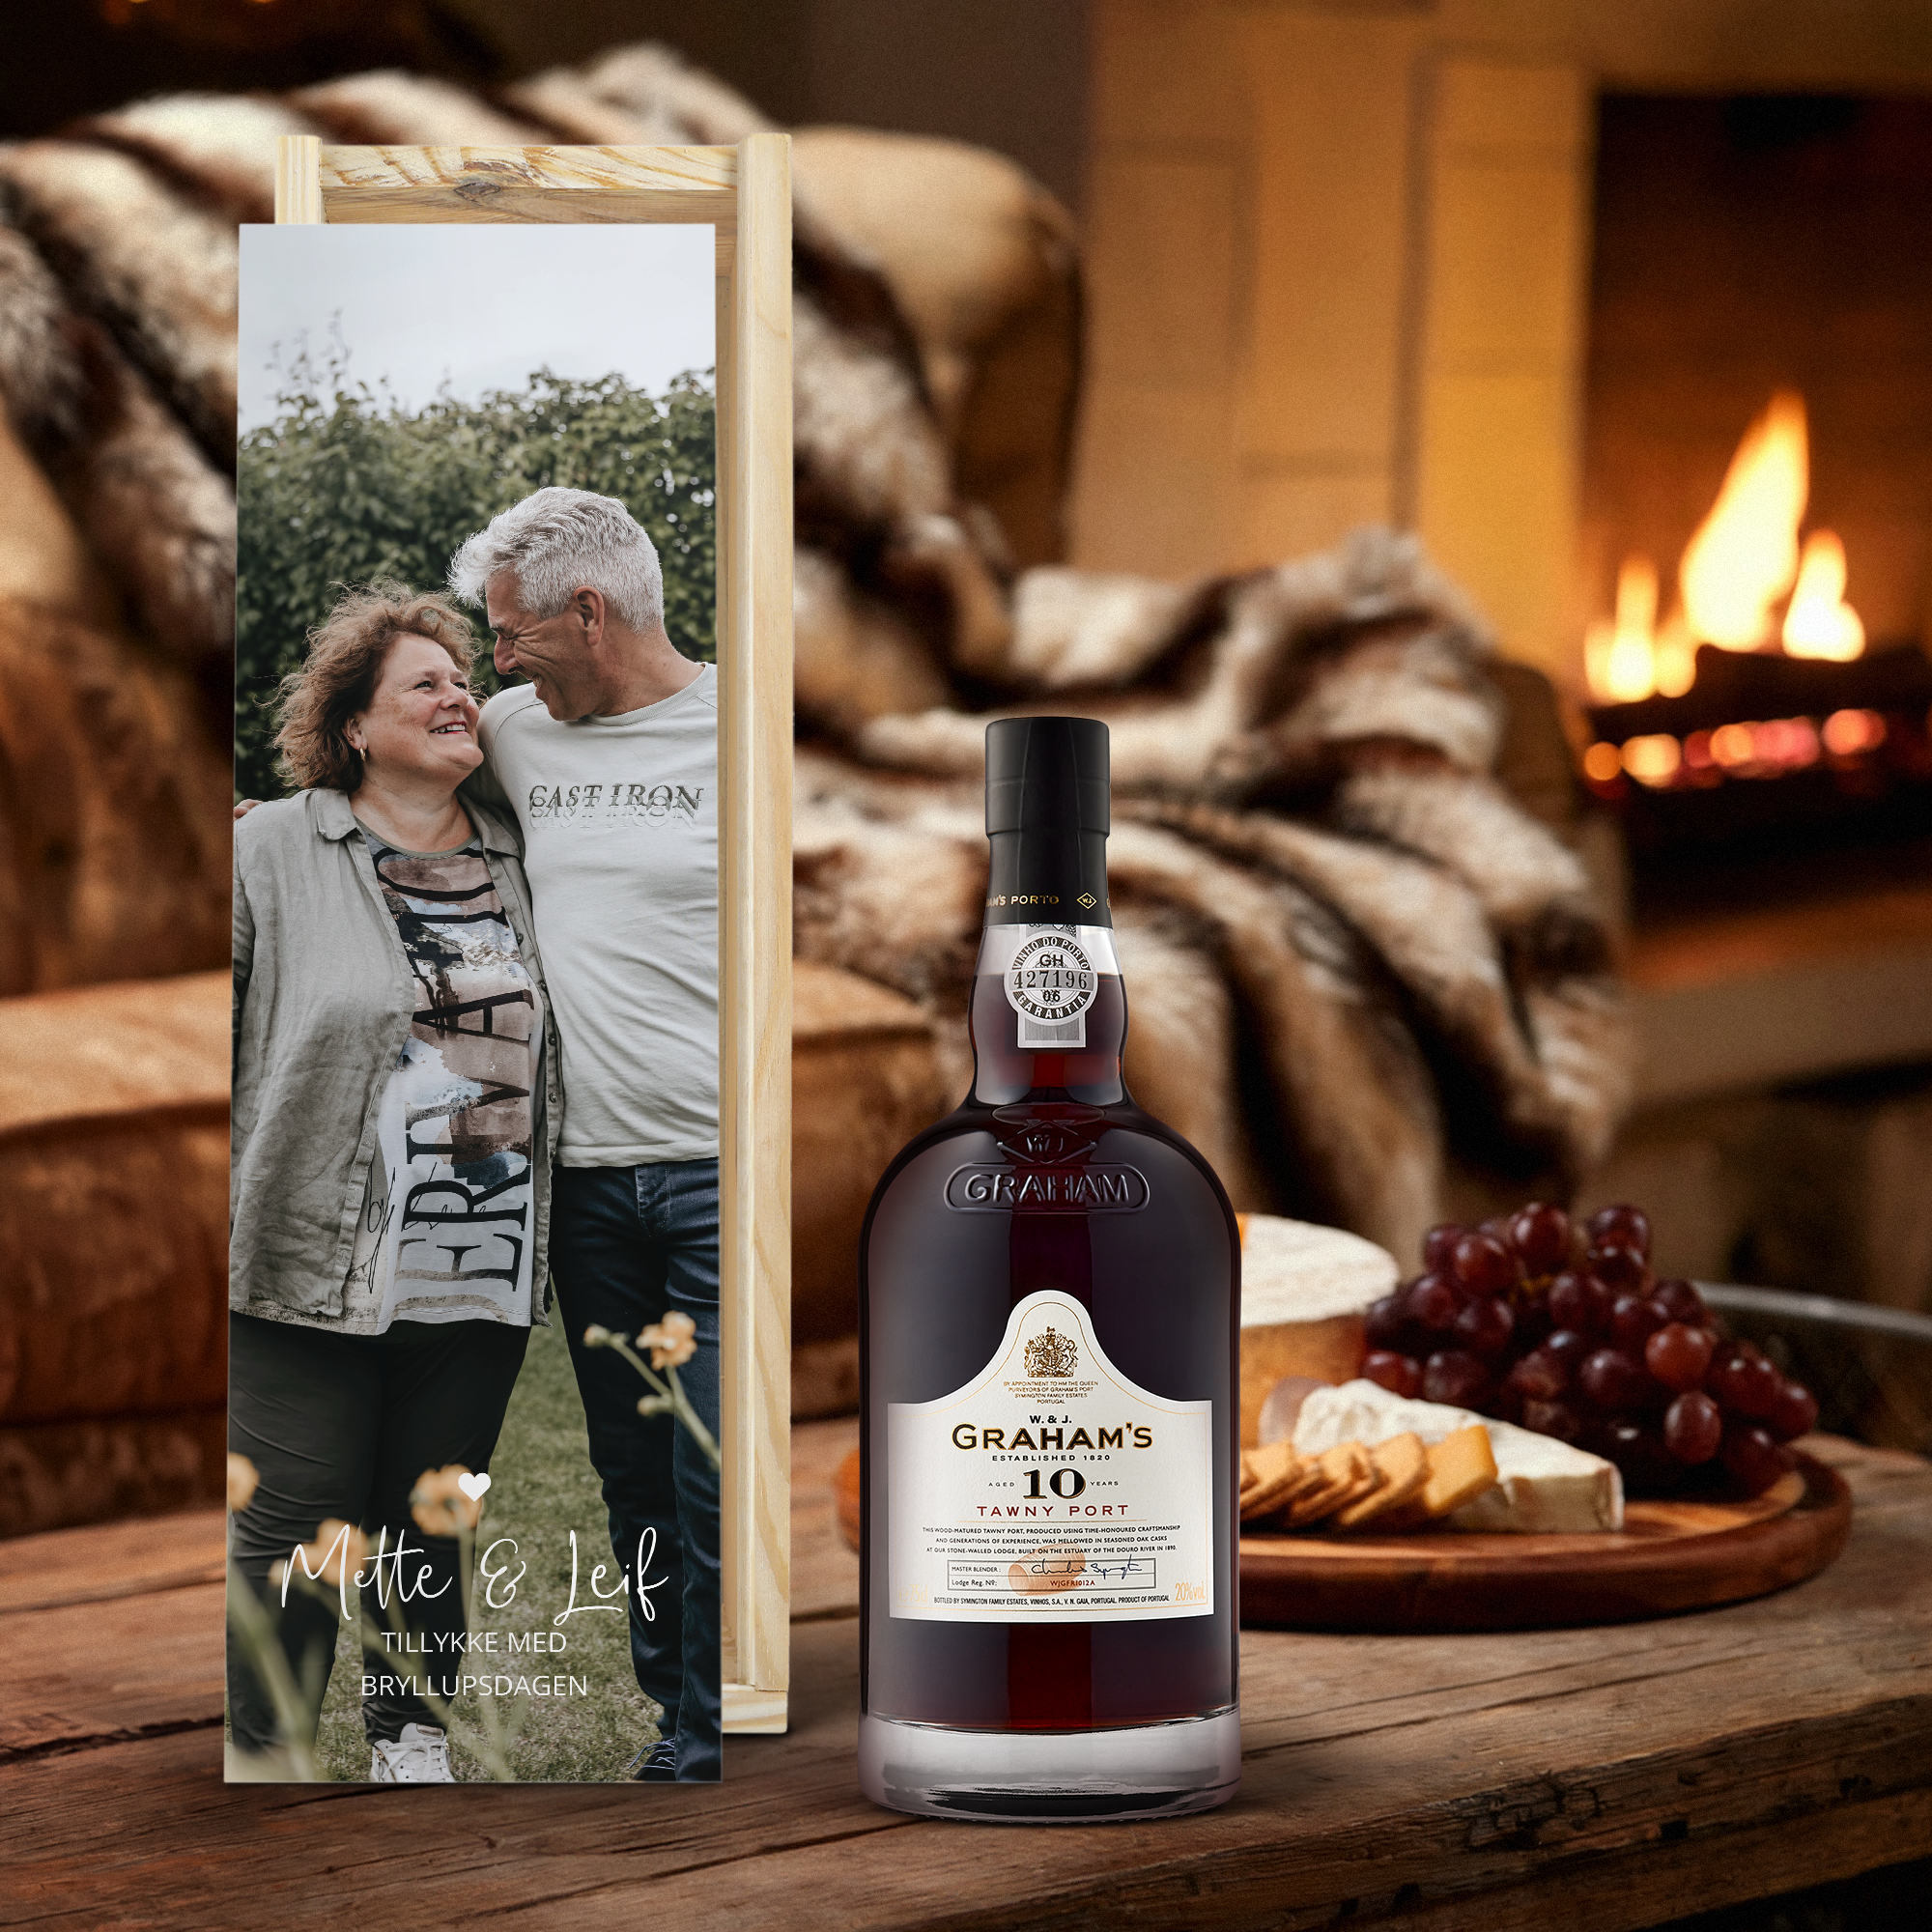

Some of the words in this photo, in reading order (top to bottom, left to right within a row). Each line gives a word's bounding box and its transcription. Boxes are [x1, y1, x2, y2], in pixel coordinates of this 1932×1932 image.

[529, 784, 603, 813] CAST
[610, 783, 704, 813] IRON
[1010, 895, 1060, 905] PORTO
[1012, 941, 1039, 970] VINHO
[1042, 937, 1058, 947] DO
[1062, 939, 1089, 969] PORTO
[1038, 953, 1064, 967] GH
[1013, 969, 1088, 990] 427196
[1042, 989, 1061, 1003] 06
[1017, 995, 1087, 1019] GARANTIA
[965, 1173, 1130, 1204] GRAHAM
[1030, 1415, 1045, 1424] W.
[1047, 1415, 1058, 1424] &
[1062, 1415, 1072, 1424] J.
[952, 1422, 1153, 1451] GRAHAM'S
[1022, 1467, 1087, 1499] 10
[977, 1505, 1054, 1517] TAWNY
[1068, 1505, 1128, 1517] PORT
[281, 1524, 453, 1621] Mette
[480, 1538, 526, 1608] &
[553, 1526, 669, 1626] Leif
[952, 1578, 969, 1587] Lodge
[971, 1578, 984, 1587] Reg.
[381, 1632, 498, 1653] TILLYKKE
[509, 1632, 567, 1653] MED
[361, 1675, 587, 1696] BRYLLUPSDAGEN
